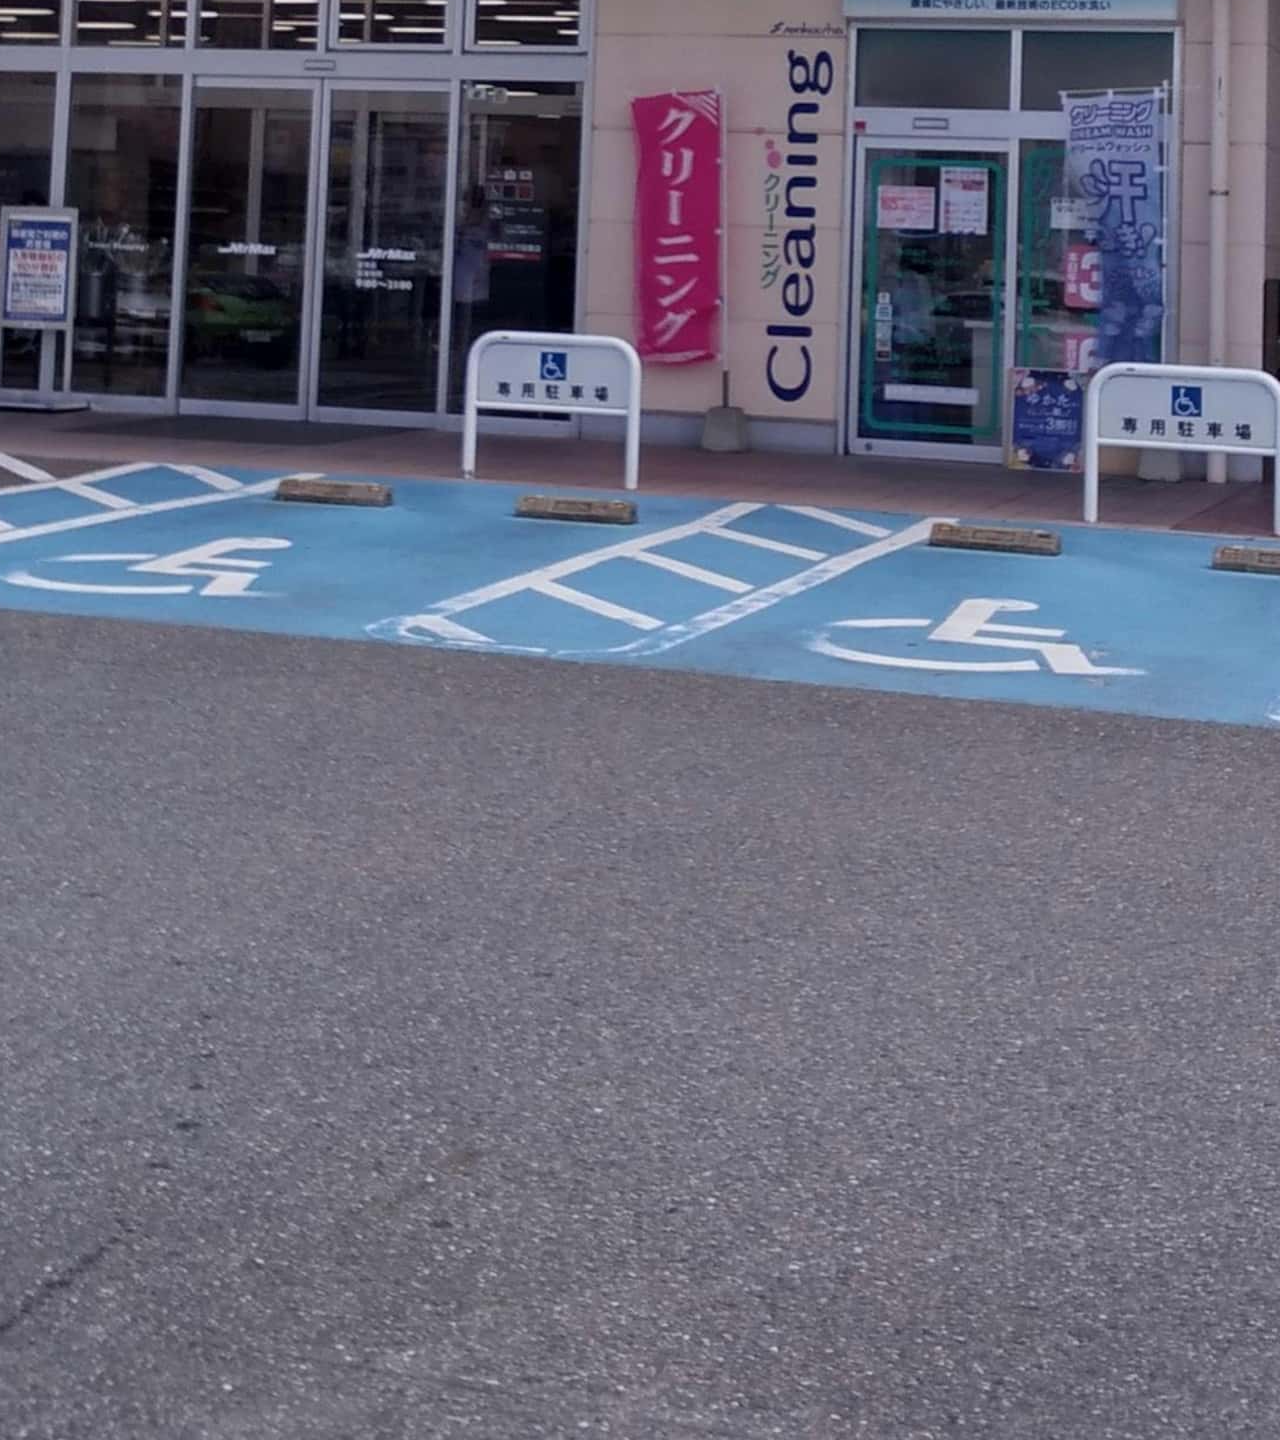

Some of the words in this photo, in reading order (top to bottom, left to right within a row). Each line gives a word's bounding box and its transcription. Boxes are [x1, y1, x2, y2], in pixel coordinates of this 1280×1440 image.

[653, 108, 700, 346] クリーニング
[761, 173, 782, 289] クリーニング
[765, 48, 834, 402] Cleaning
[498, 382, 609, 402] 専用駐車場
[1122, 417, 1252, 440] 専用駐車場
